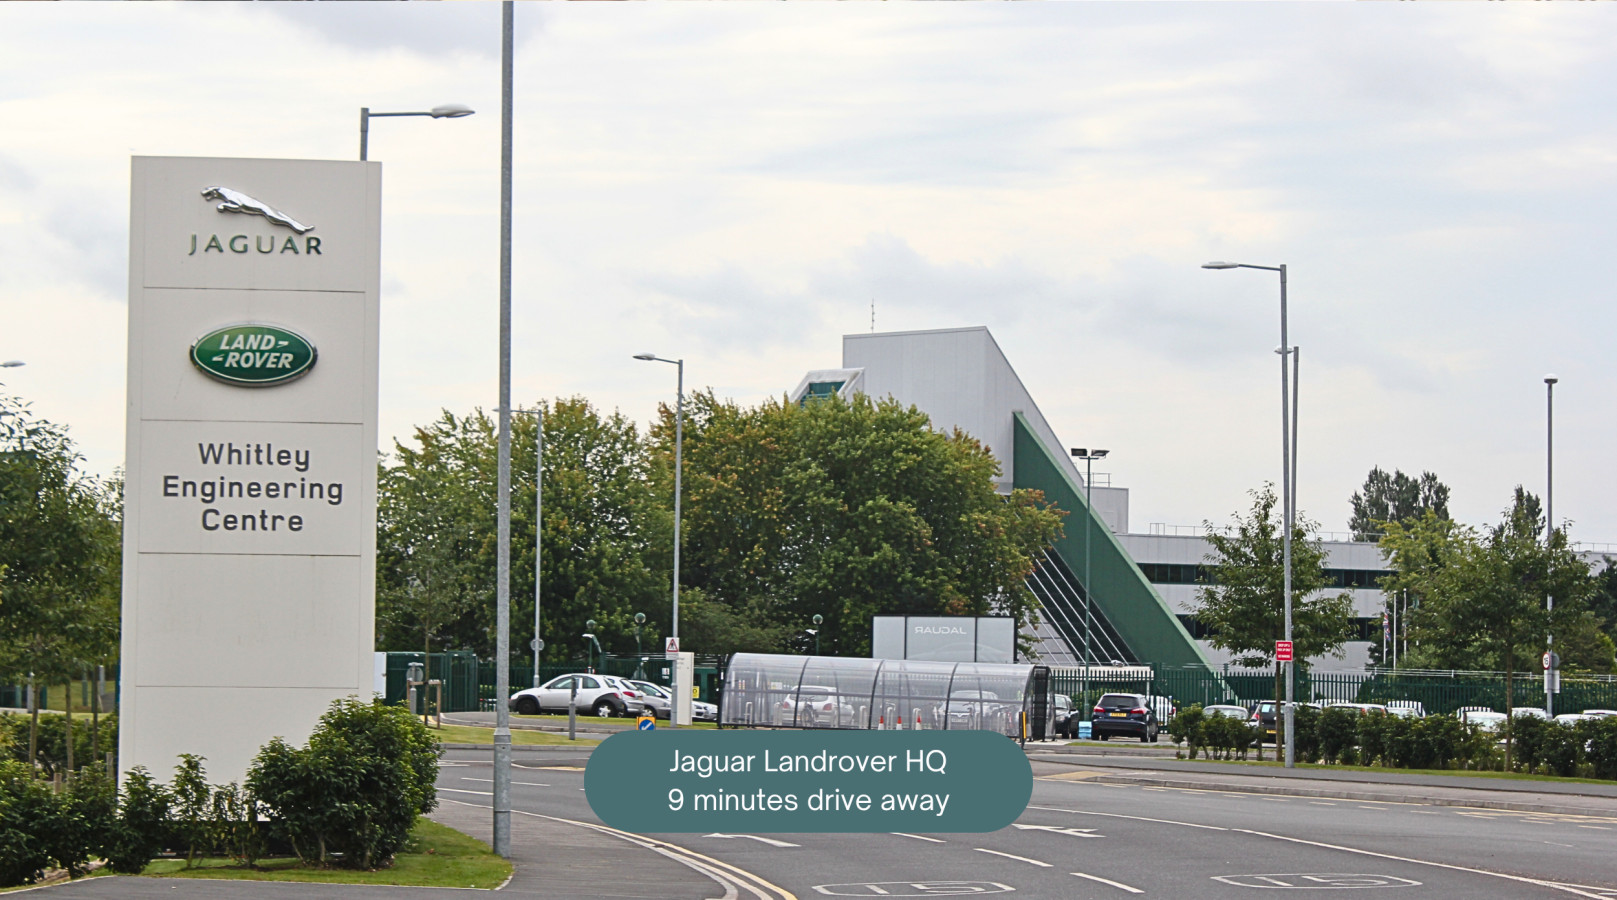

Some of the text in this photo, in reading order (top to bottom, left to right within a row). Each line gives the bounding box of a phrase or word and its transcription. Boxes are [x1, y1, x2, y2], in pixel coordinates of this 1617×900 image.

[188, 234, 322, 256] JAGUAR
[219, 334, 276, 350] LAND
[225, 352, 294, 369] ROVER
[198, 443, 310, 472] Whitley
[163, 476, 342, 506] Engineering
[202, 509, 304, 532] Centre
[865, 882, 985, 894] 15
[1254, 875, 1388, 887] 15
